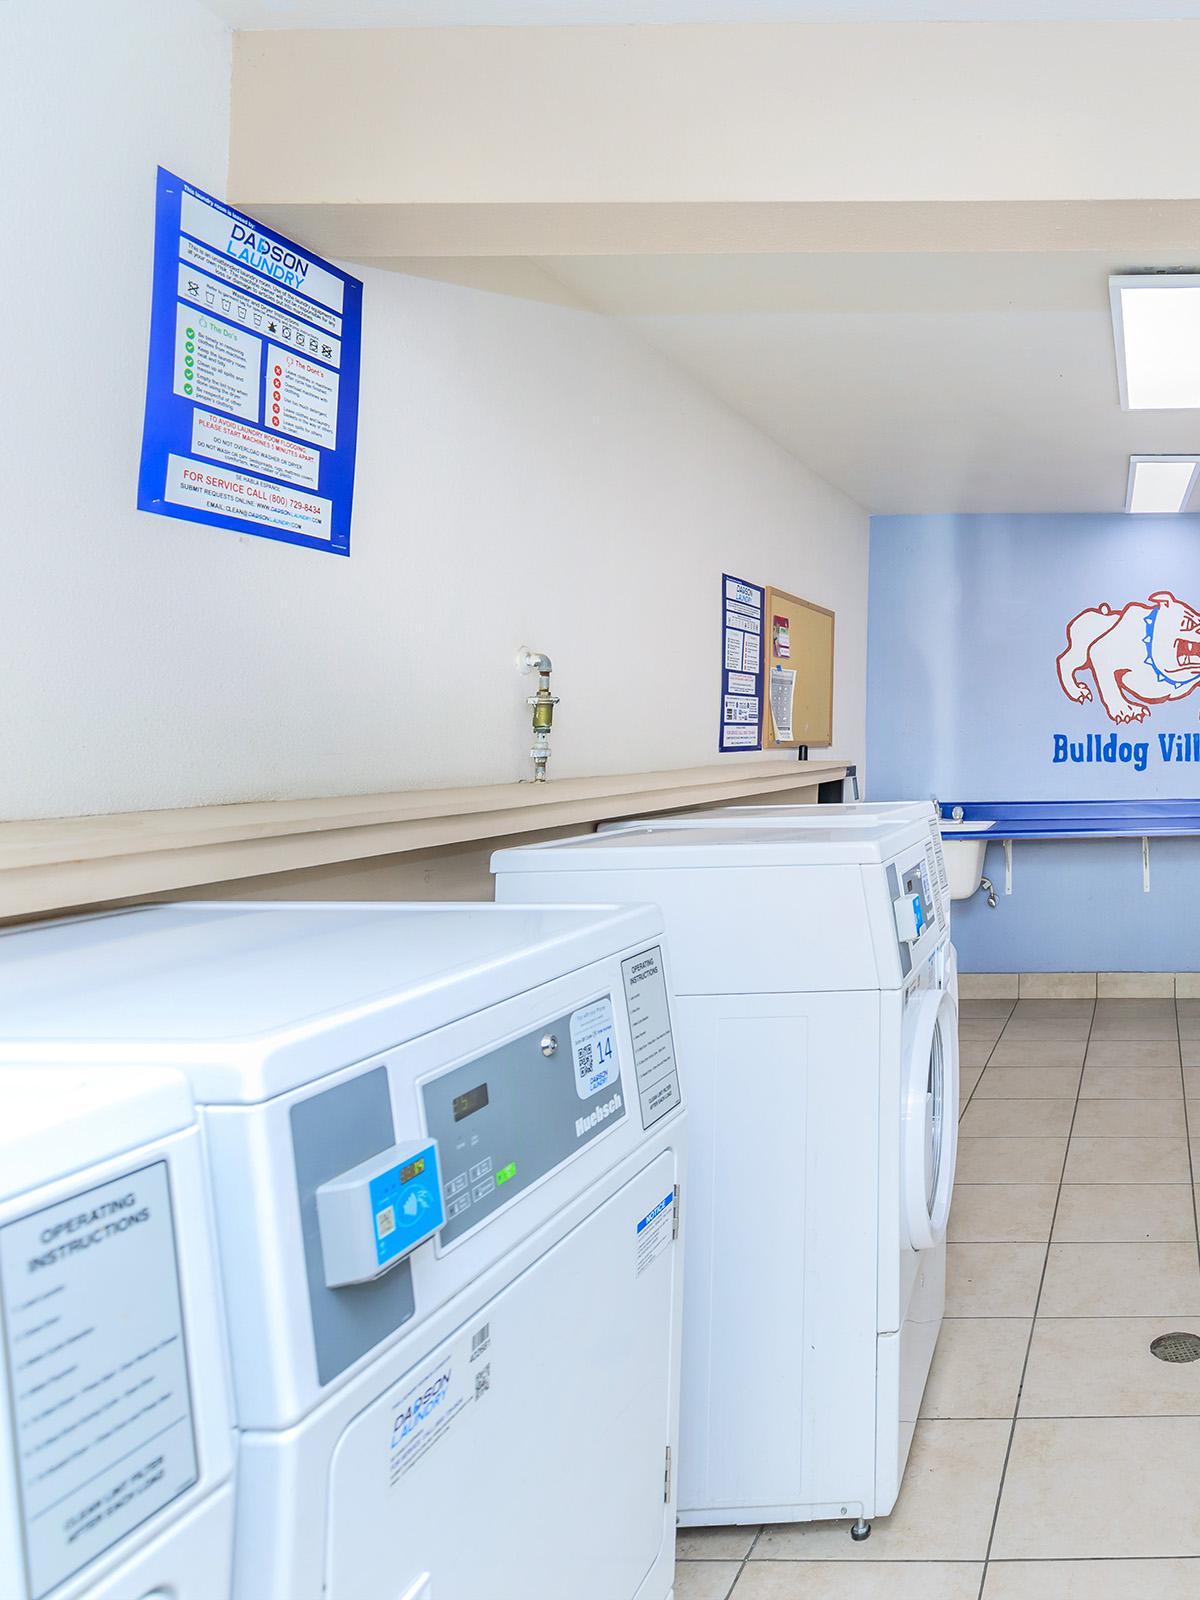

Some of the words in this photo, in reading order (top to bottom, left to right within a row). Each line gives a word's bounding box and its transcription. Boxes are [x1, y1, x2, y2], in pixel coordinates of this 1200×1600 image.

[227, 240, 304, 288] LAUNDRY
[231, 224, 308, 276] DADSON
[295, 359, 304, 369] The
[180, 482, 202, 493] SUBMIT
[203, 488, 234, 501] REQUESTS
[183, 469, 203, 483] FOR
[205, 475, 243, 493] SERVICE
[246, 486, 267, 500] CALL
[269, 493, 287, 507] (800)
[289, 499, 320, 515] 729-8434
[1052, 733, 1149, 771] Bulldog
[630, 967, 658, 986] INSTRUCTIONS
[631, 958, 654, 974] OPERATING
[596, 1036, 612, 1064] 14
[576, 1093, 622, 1138] Huebsch
[28, 1208, 151, 1274] INSTRUCTIONS
[39, 1192, 136, 1245] OPERATING
[394, 1368, 452, 1432] DADSON
